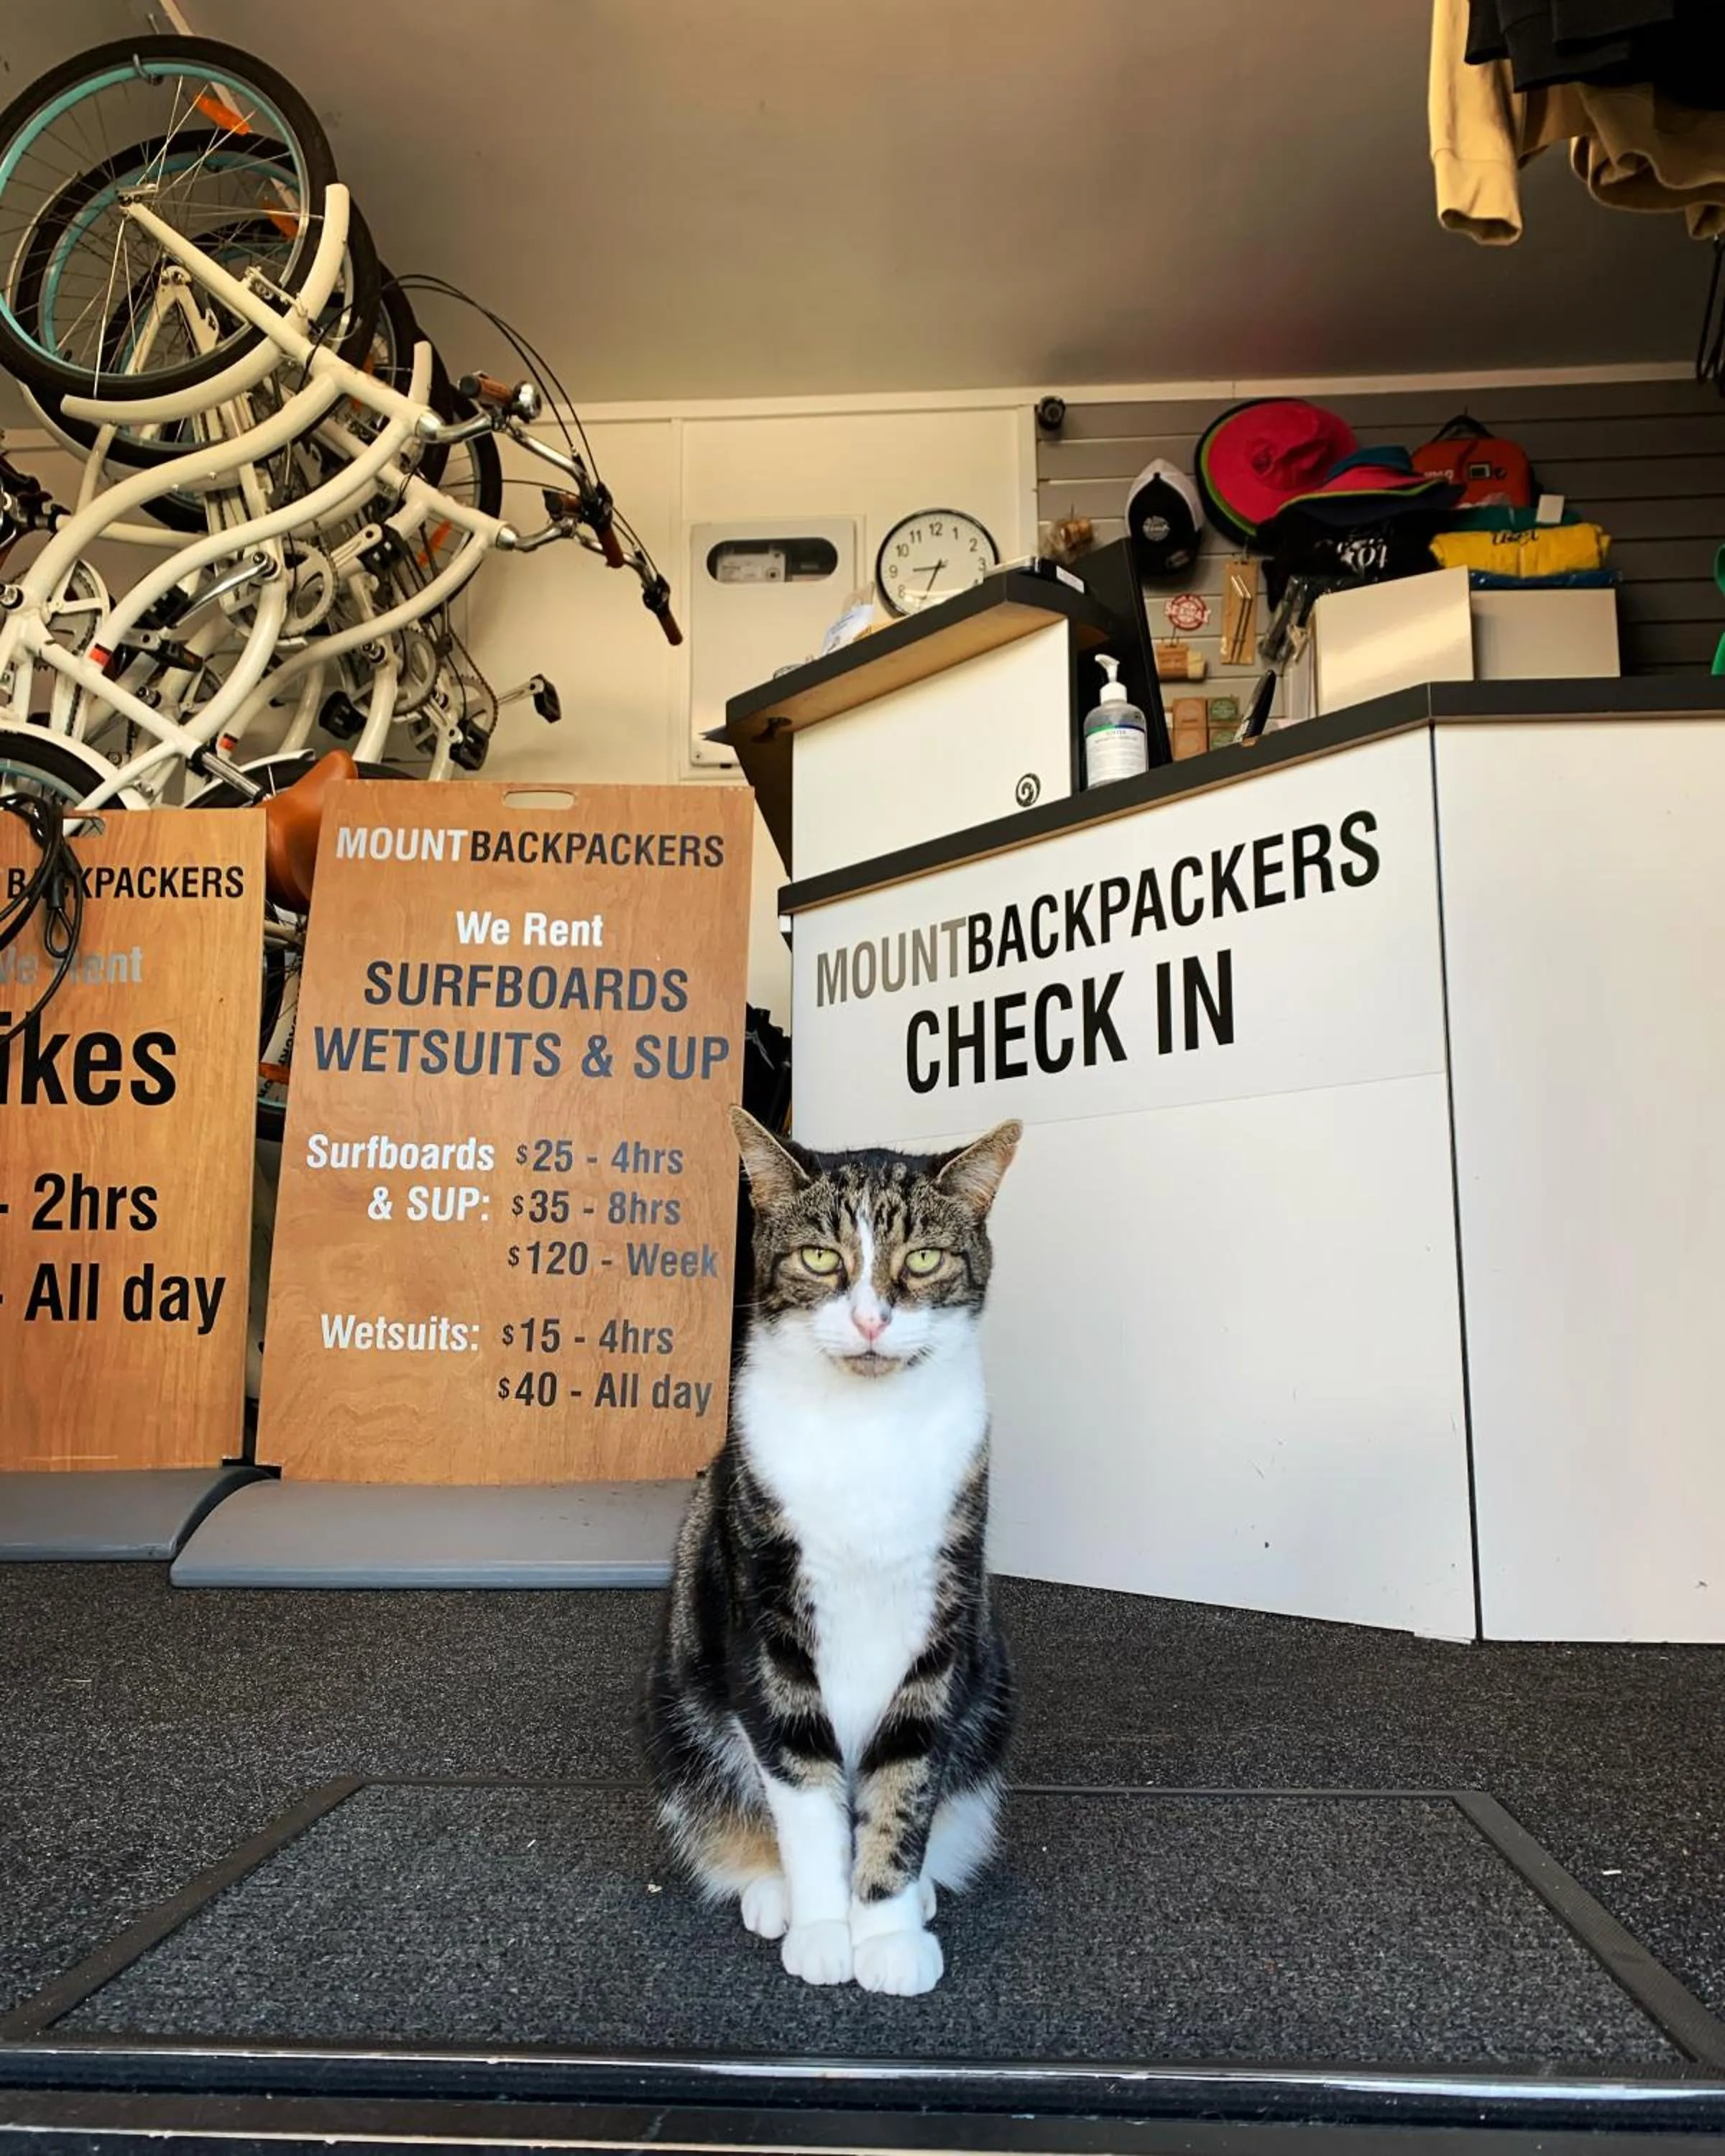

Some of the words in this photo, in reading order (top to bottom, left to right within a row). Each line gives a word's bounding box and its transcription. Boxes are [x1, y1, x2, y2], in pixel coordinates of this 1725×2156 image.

[896, 543, 909, 557] 10
[909, 530, 921, 543] 11
[929, 522, 943, 536] 12
[952, 526, 958, 540] 1
[970, 538, 978, 552] 2
[888, 565, 898, 579] 9
[978, 557, 986, 571] 3
[336, 826, 724, 867] MOUNTBACKPACKERS
[7, 867, 244, 898] BKPACKERS
[816, 809, 1380, 1006] MOUNTBACKPACKERS
[456, 911, 510, 945] We
[523, 911, 603, 947] Rent
[364, 961, 689, 1012] SURFBOARDS
[906, 970, 1128, 1095] CHECK
[1156, 949, 1236, 1055] IN
[314, 1026, 562, 1077] WETSUITS
[581, 1034, 612, 1077] &
[633, 1035, 730, 1079] SUP
[306, 1133, 495, 1171] Surfboards
[516, 1140, 574, 1172] $25
[611, 1141, 684, 1175] 4hrs
[32, 1172, 158, 1231] 2hrs
[367, 1186, 392, 1220] &
[407, 1187, 490, 1221] SUP:
[512, 1189, 569, 1223] $35
[608, 1191, 681, 1225] 8hrs
[507, 1241, 589, 1276] $120
[627, 1242, 718, 1278] Week
[24, 1263, 99, 1322] All
[123, 1263, 226, 1335] day
[321, 1314, 479, 1351] Wetsuits:
[502, 1317, 561, 1353] $15
[599, 1319, 673, 1355] 4hrs
[497, 1370, 557, 1406] $40
[594, 1372, 638, 1408] All
[652, 1374, 712, 1417] day
